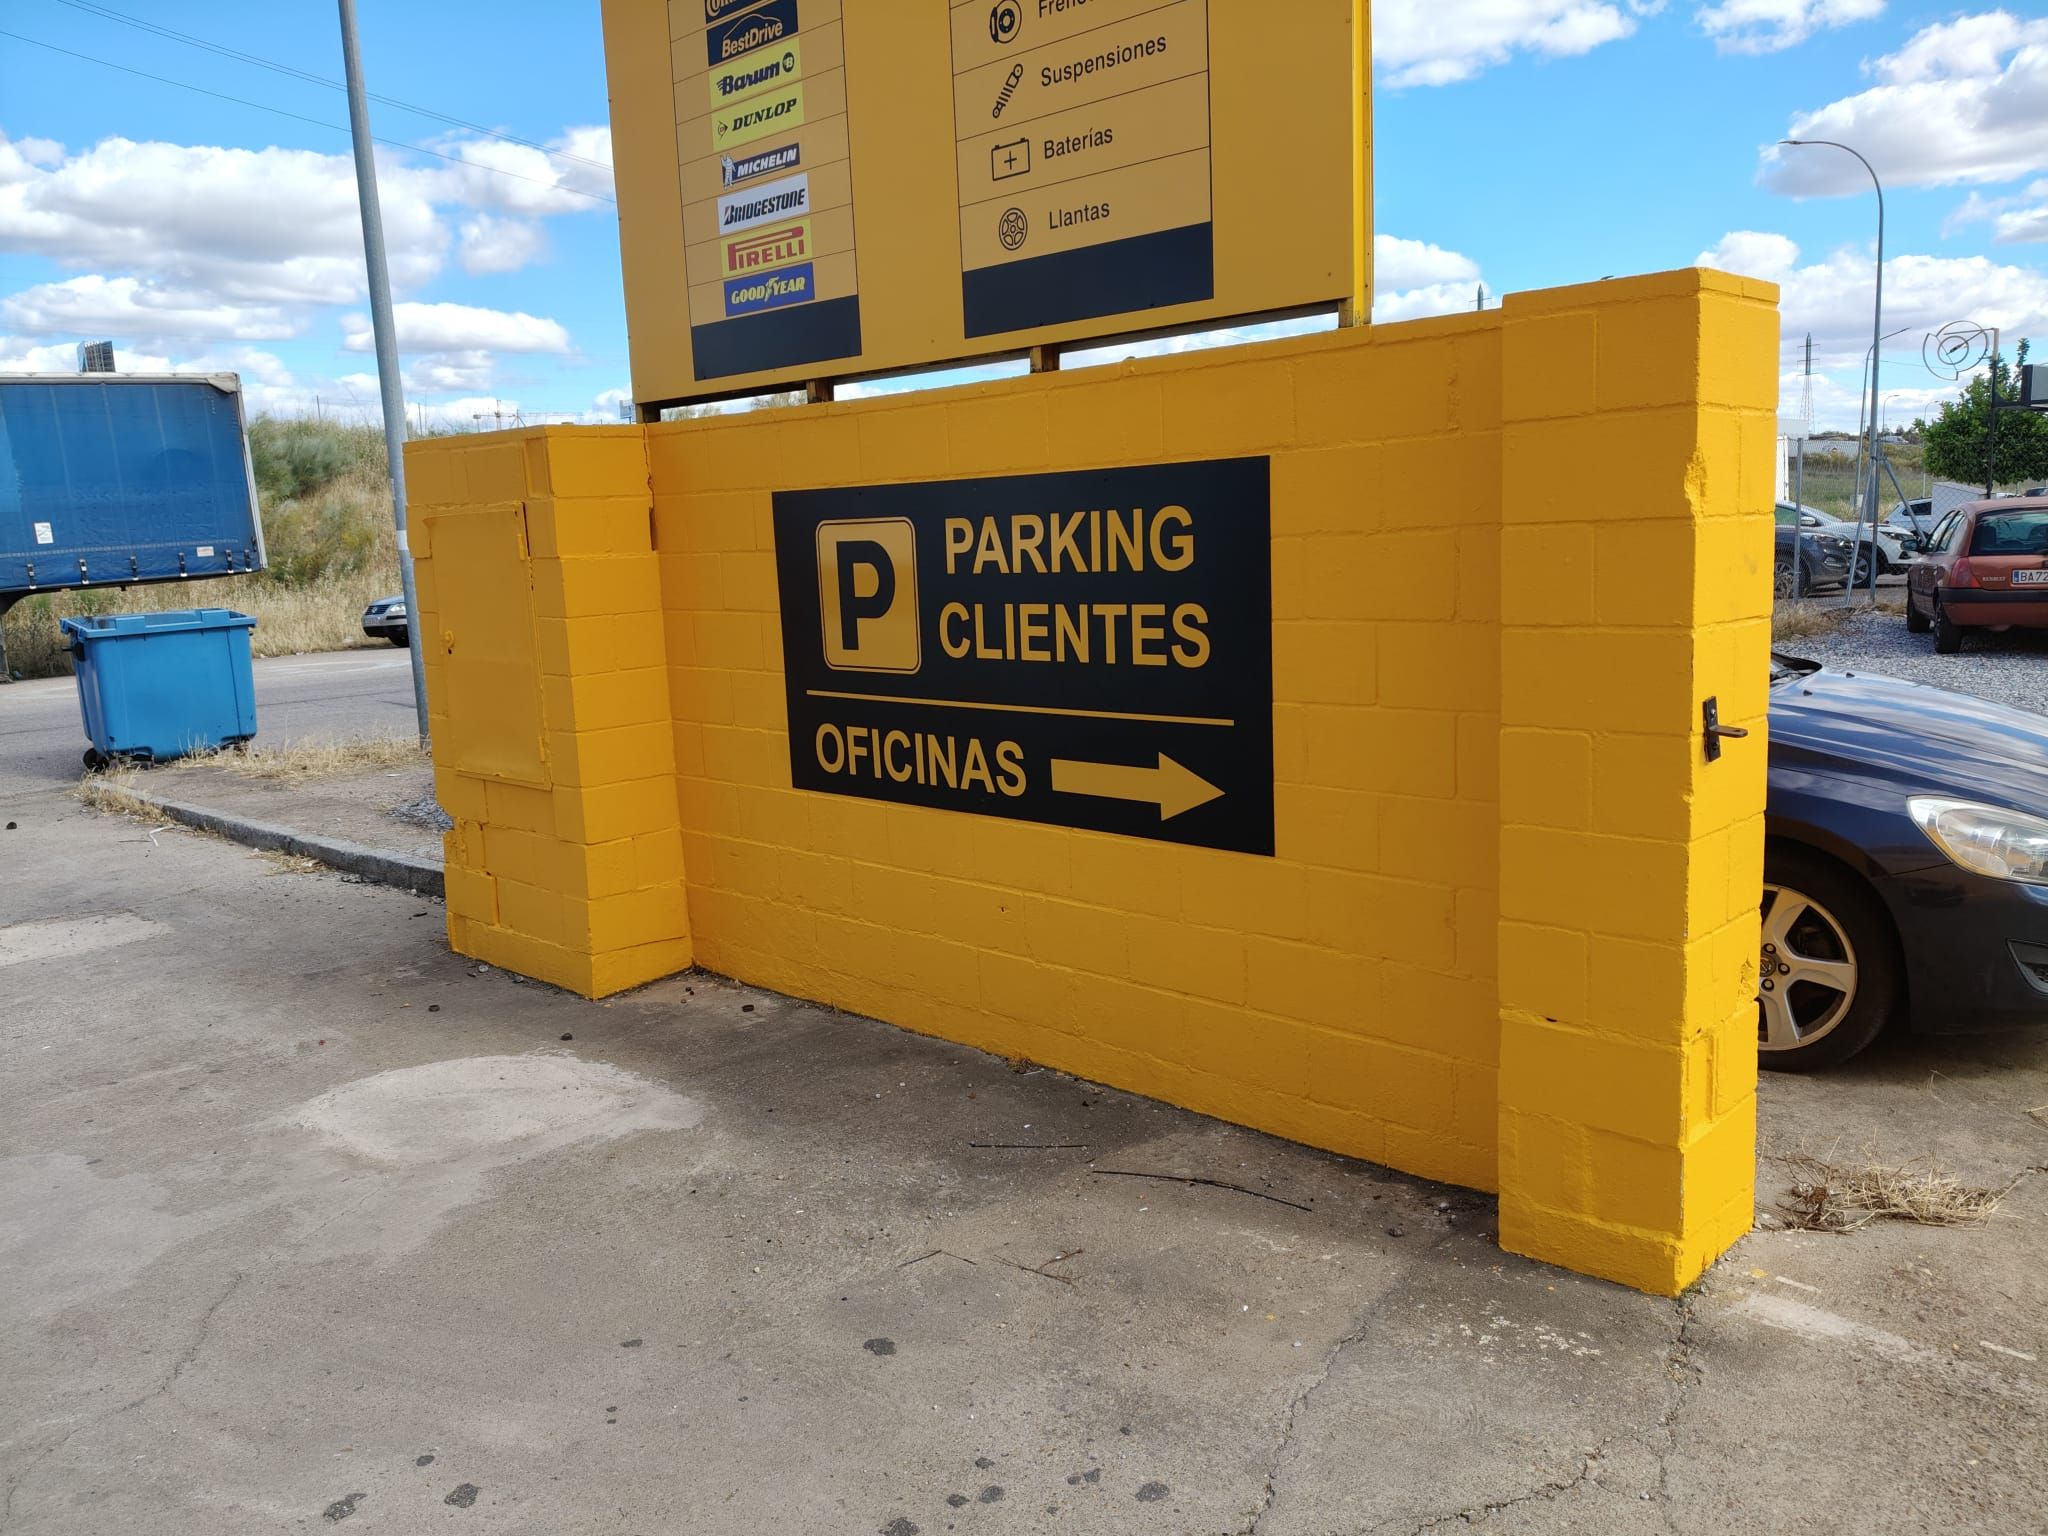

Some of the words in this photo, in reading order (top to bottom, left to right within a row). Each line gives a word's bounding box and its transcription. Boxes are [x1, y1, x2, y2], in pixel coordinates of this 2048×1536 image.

[722, 22, 783, 58] BestDrive
[716, 62, 780, 96] Barum
[1041, 36, 1167, 87] Suspensiones
[732, 98, 797, 131] DUNLOP
[737, 148, 797, 177] MICHELIN
[1044, 128, 1113, 159] Baterías
[724, 188, 806, 226] BRIDGESTONE
[1049, 202, 1110, 230] Llantas
[728, 226, 804, 272] PIRELLI
[944, 505, 1195, 575] PARKING
[836, 540, 896, 651] P
[939, 601, 1211, 669] CLIENTES
[815, 723, 1027, 797] OFICINAS
